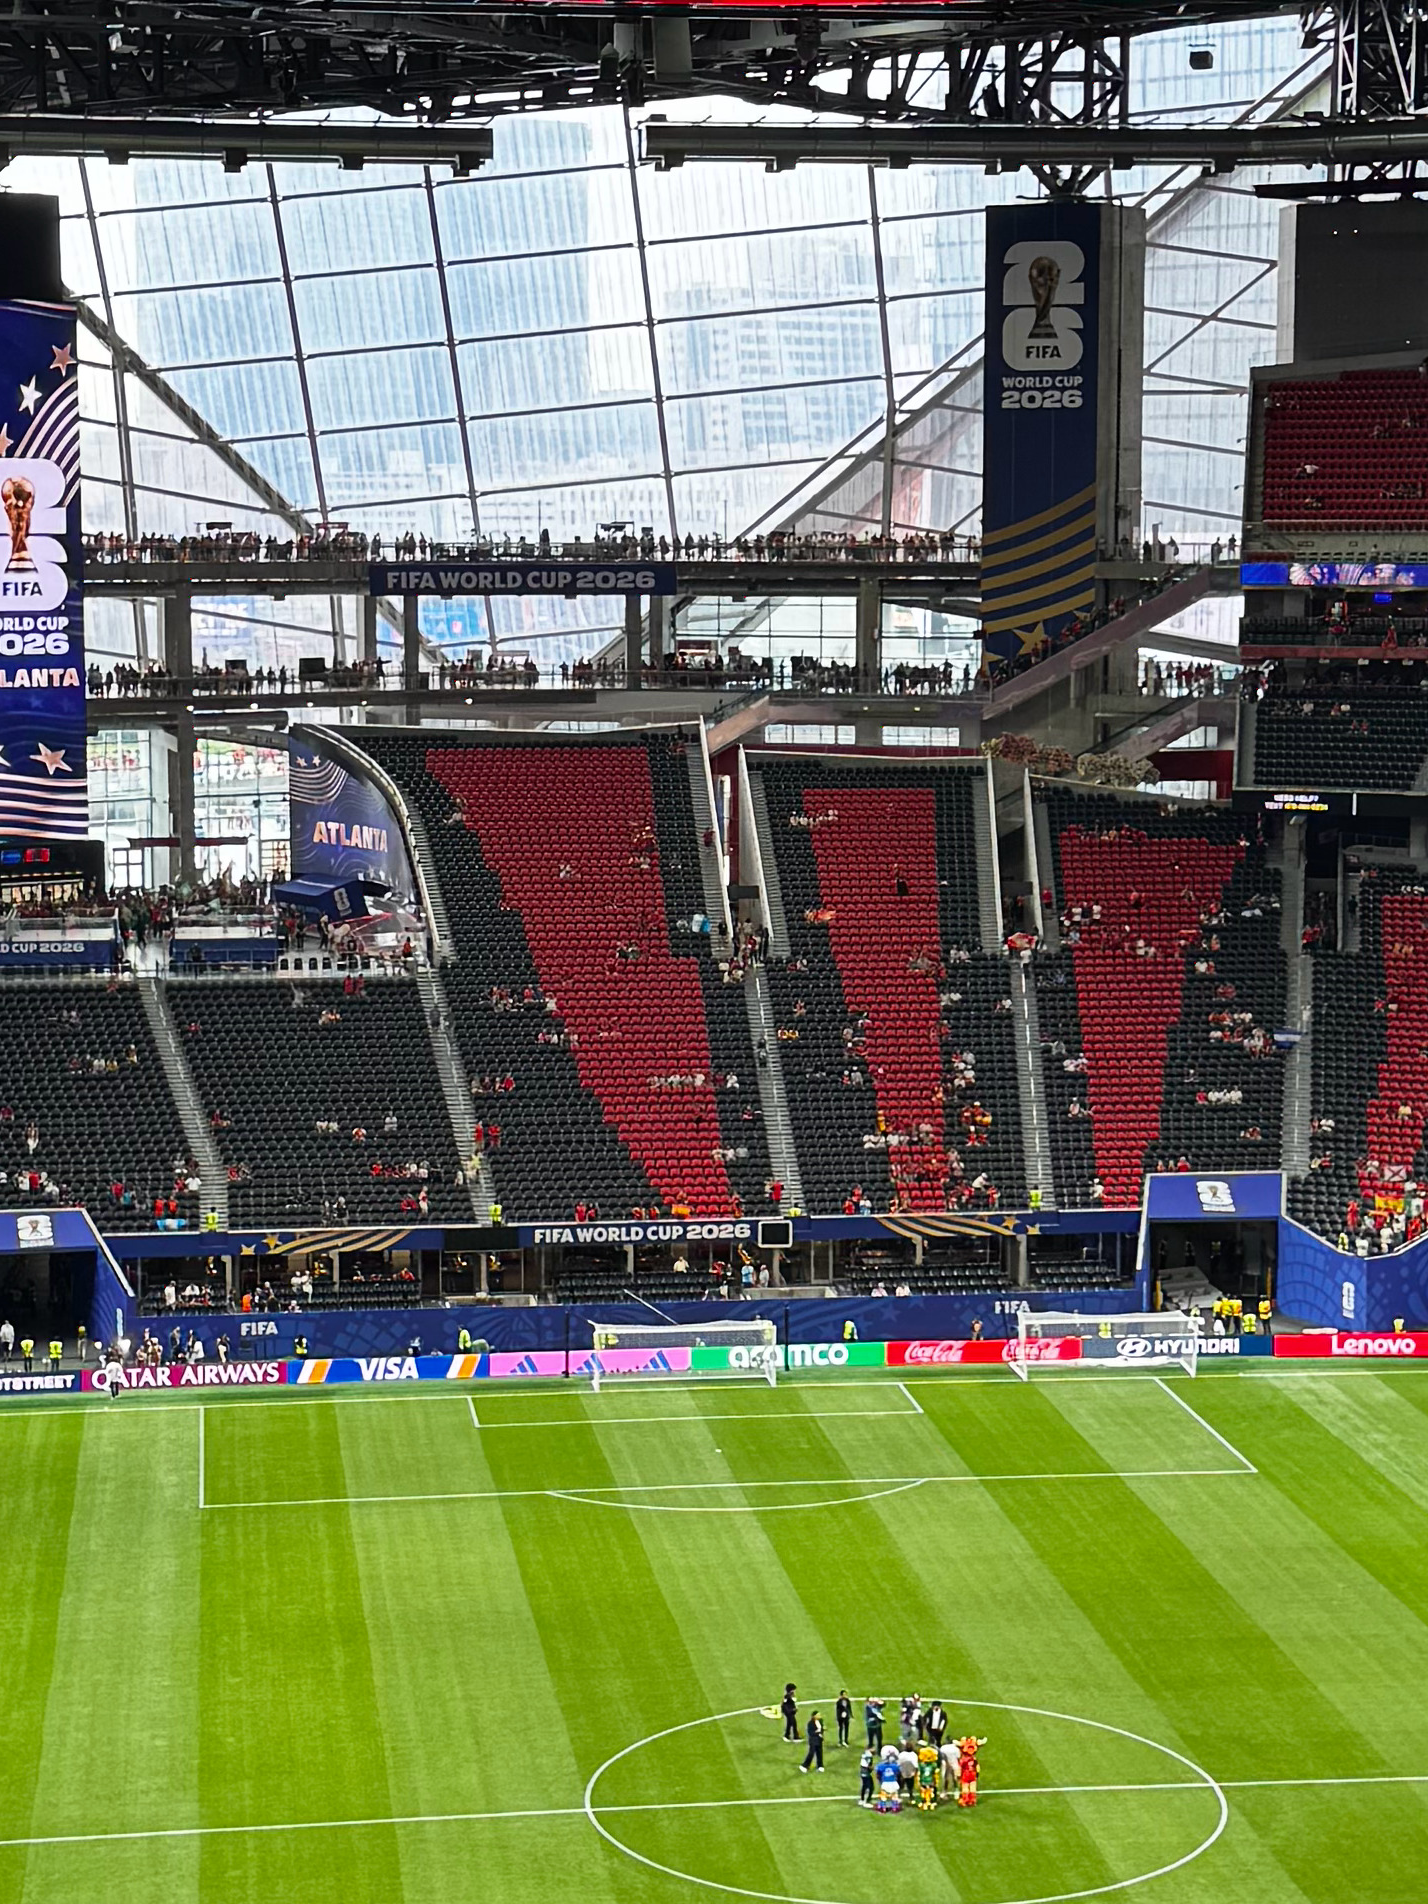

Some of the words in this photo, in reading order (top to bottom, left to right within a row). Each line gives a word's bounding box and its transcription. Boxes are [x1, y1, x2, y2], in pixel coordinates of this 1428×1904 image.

[1025, 345, 1062, 359] FIFA
[1002, 376, 1053, 388] WORLD
[1054, 375, 1083, 387] CUP
[1001, 390, 1083, 409] 2026
[1, 581, 43, 596] FIFA
[387, 571, 437, 589] FIFA
[438, 571, 523, 589] WORLD
[525, 571, 572, 589] CUP
[575, 571, 656, 588] 2026
[36, 615, 70, 631] CUP
[312, 820, 389, 854] ATLANTA
[11, 942, 37, 955] CUP
[38, 941, 85, 955] 2026
[534, 1228, 573, 1245] FIFA
[574, 1227, 641, 1243] WORLD
[642, 1226, 683, 1241] CUP
[685, 1224, 751, 1239] 2026
[994, 1300, 1031, 1314] FIFA
[240, 1321, 279, 1336] FIFA
[1153, 1337, 1240, 1354] HYUNDAI
[1331, 1335, 1416, 1355] Lenovo
[90, 1365, 173, 1392] QATAR
[179, 1362, 280, 1386] AIRWAYS
[354, 1356, 420, 1381] VISA
